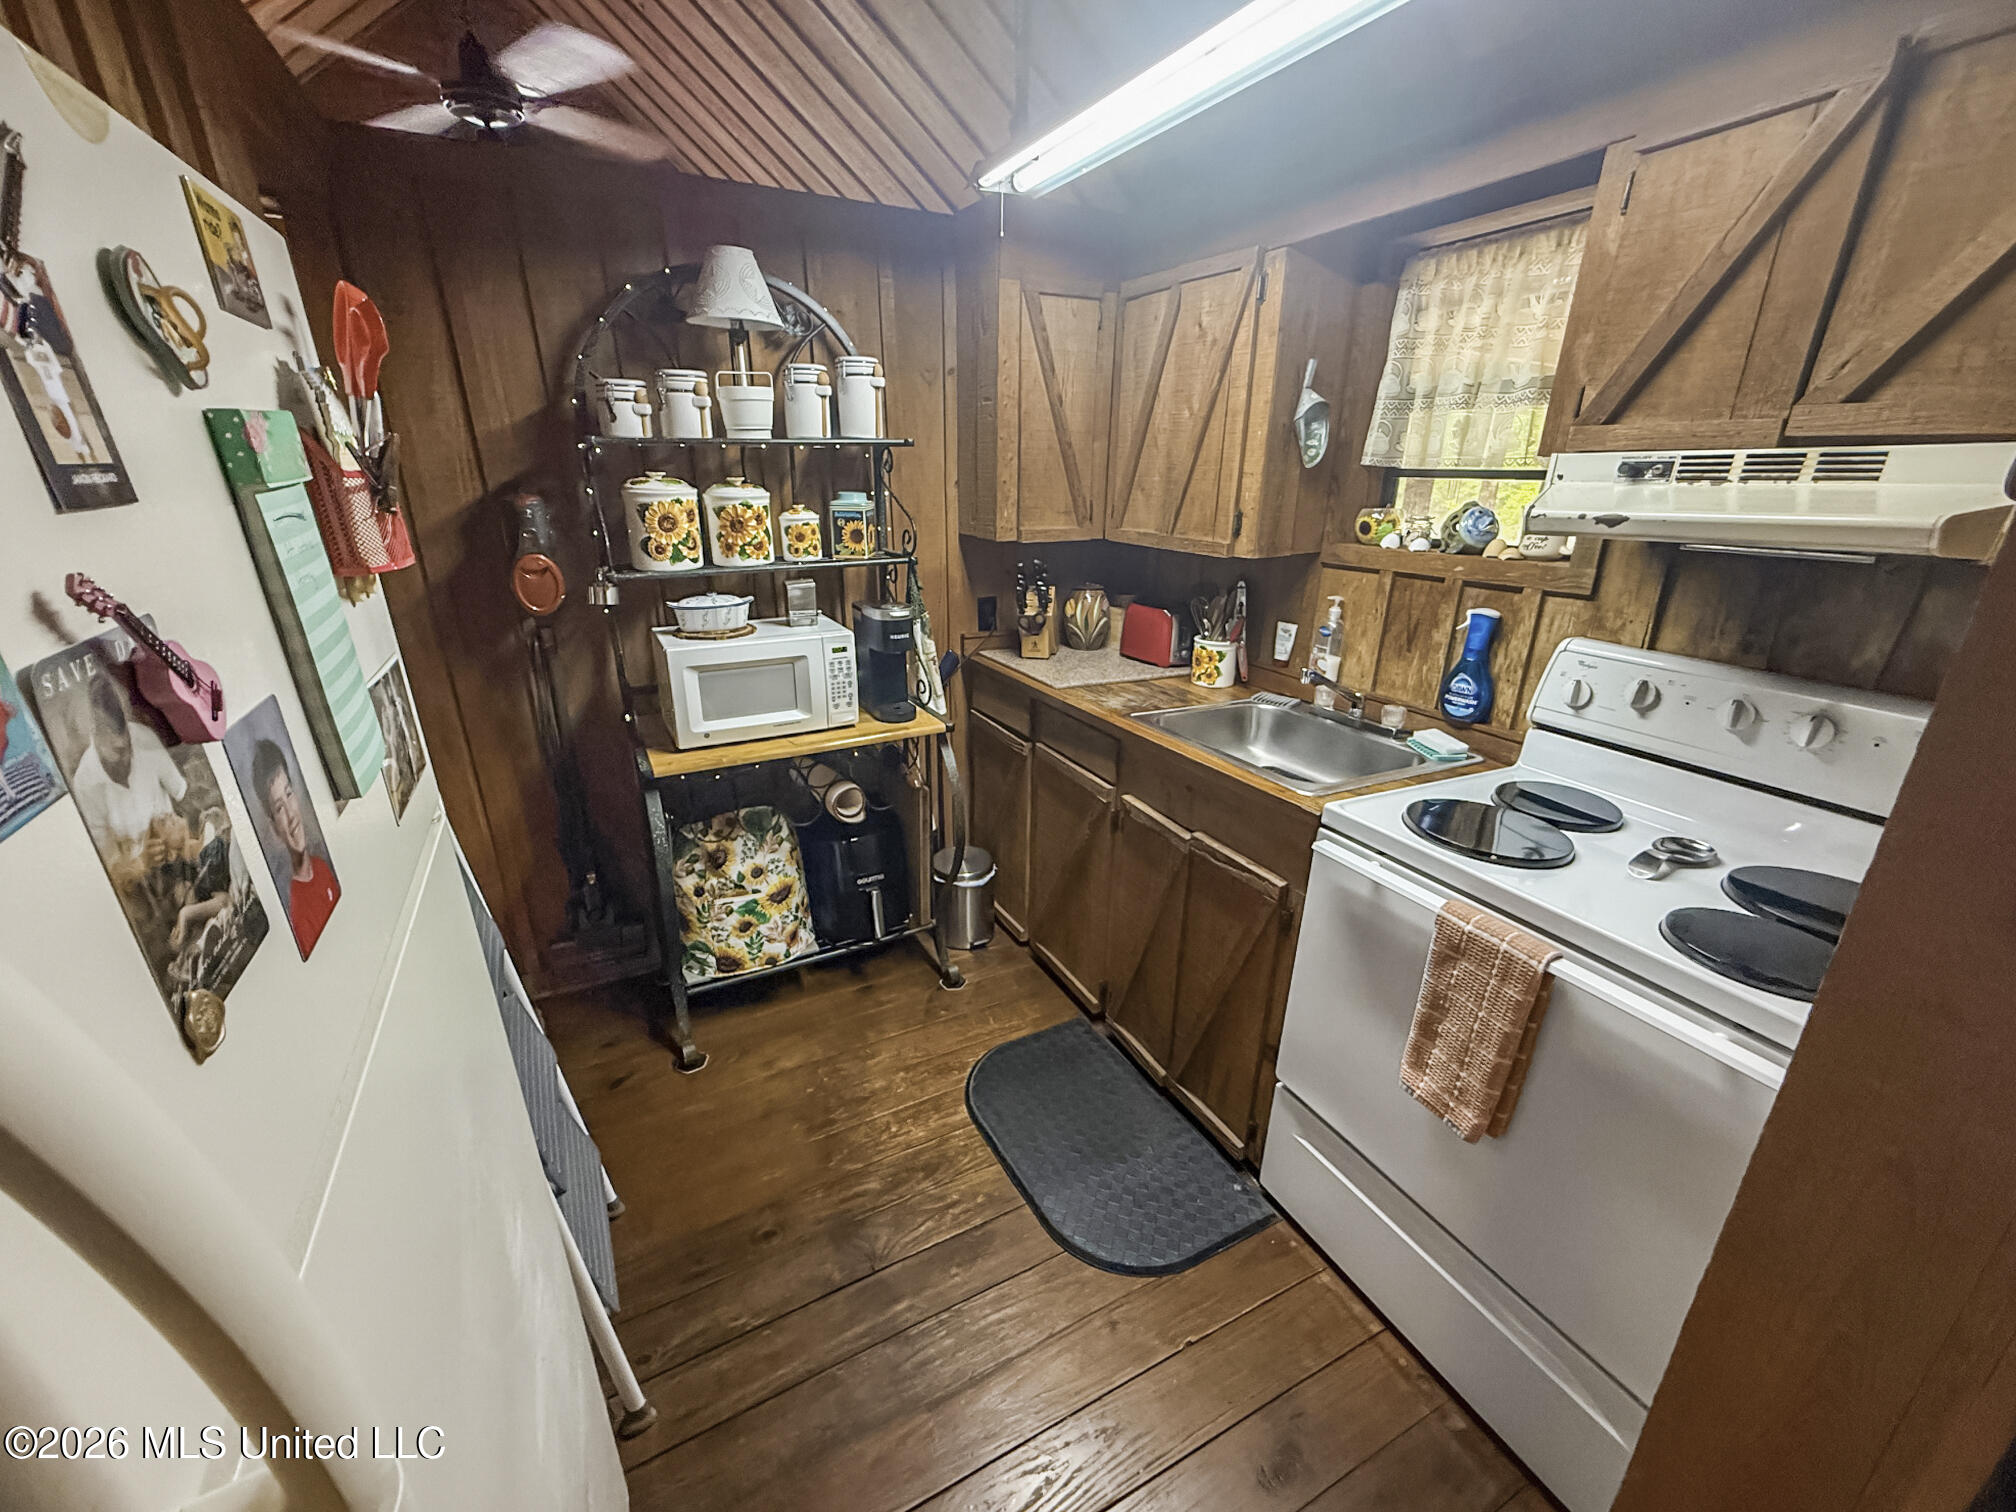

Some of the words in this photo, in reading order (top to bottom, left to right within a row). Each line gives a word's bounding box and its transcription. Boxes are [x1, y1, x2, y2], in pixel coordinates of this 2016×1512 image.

[889, 632, 910, 640] KEURIG
[41, 653, 97, 698] SAVE
[1452, 682, 1472, 694] DAWN
